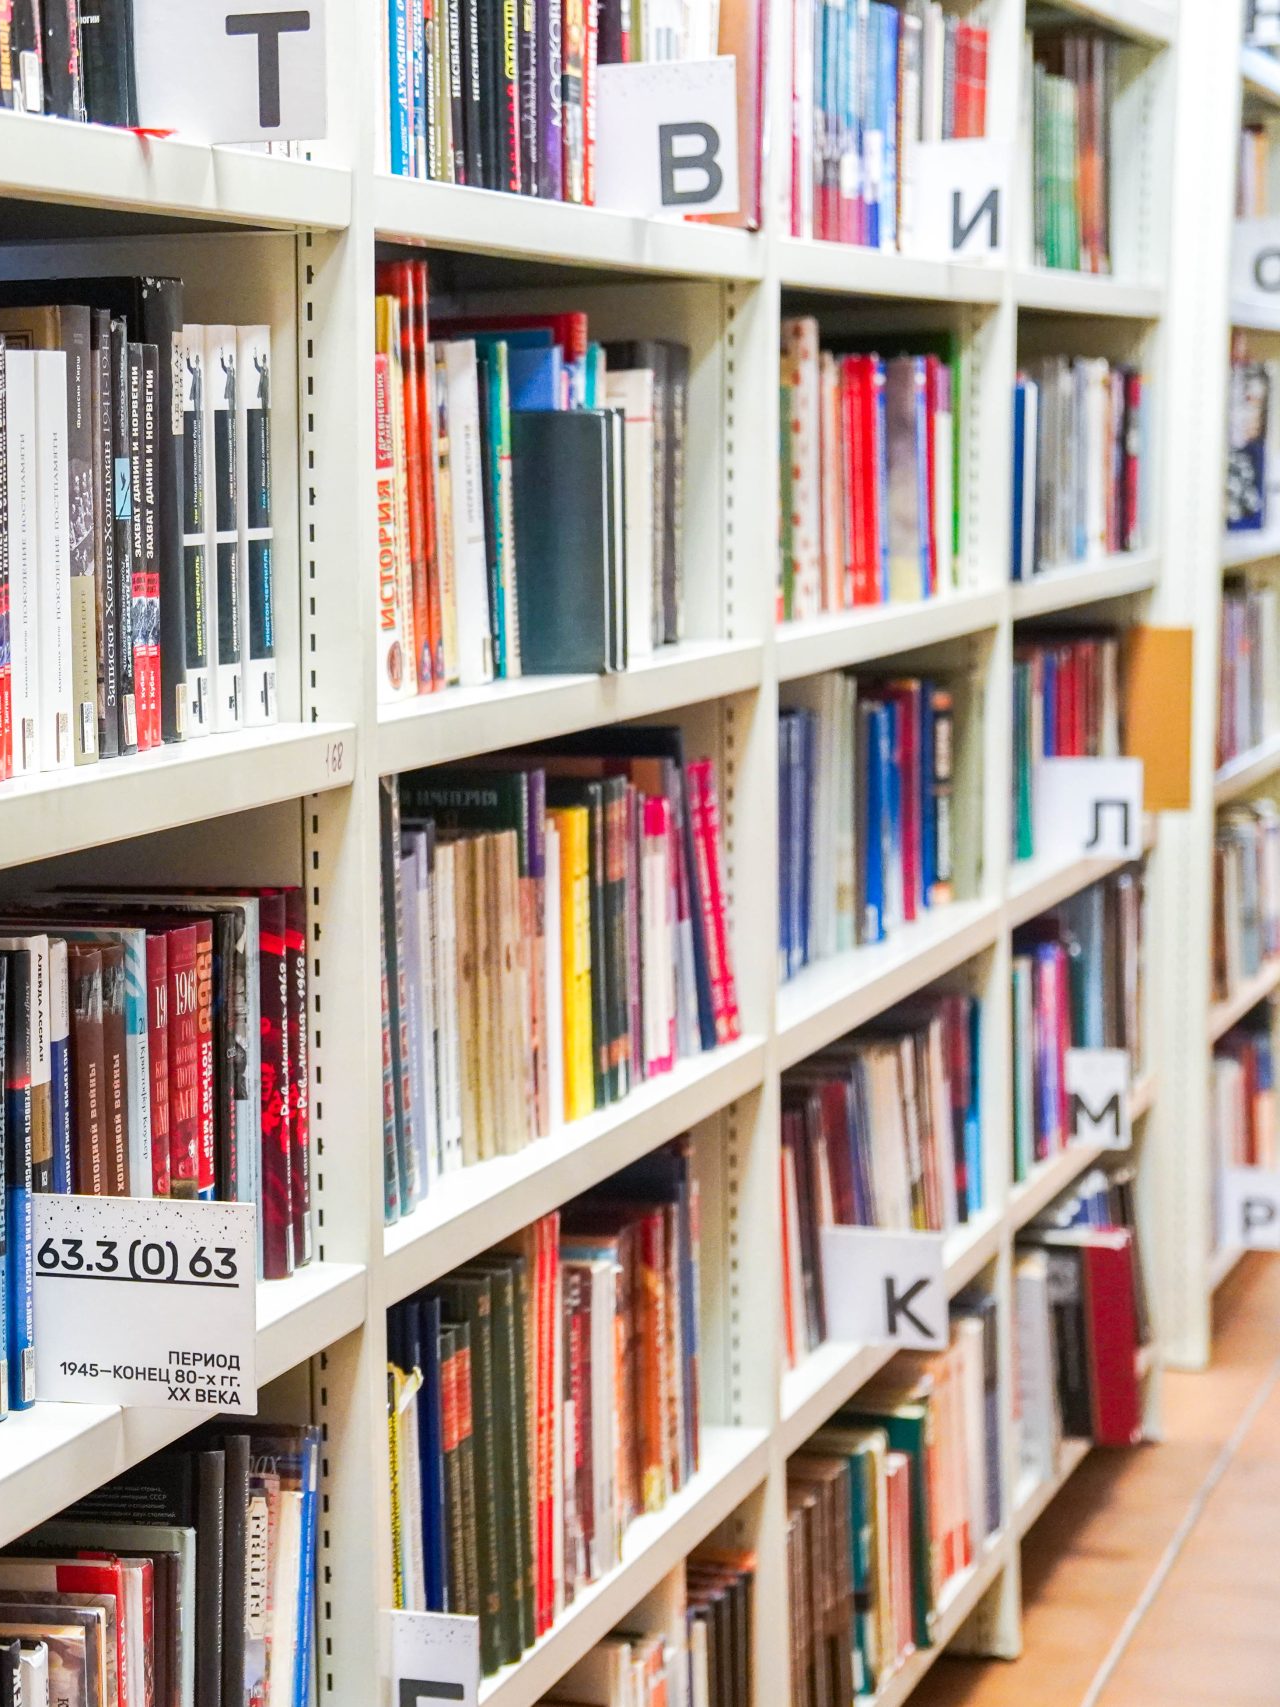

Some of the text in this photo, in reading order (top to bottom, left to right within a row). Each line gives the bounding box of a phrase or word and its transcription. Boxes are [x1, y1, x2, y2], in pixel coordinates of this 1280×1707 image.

[225, 10, 311, 128] Т
[658, 120, 724, 206] В
[949, 187, 1000, 251] И
[74, 355, 83, 429] Франсин Хирш
[130, 365, 144, 558] ЗАХВАТ ДАНИИ И НОРВЕГИИ
[144, 369, 154, 559] ЗАХВАТ ДАНИИ И НОРВЕГИИ
[101, 332, 116, 707] Записки Хелене Хольцман 1941-1944
[376, 478, 396, 632] ИСТОРИЯ
[195, 610, 203, 657] УИНСТОН
[263, 602, 271, 647] УИНСТОН
[1086, 798, 1131, 849] Л
[24, 1083, 32, 1134] КРЕПОСТЬ
[88, 1062, 98, 1120] ВОЙНЫ
[201, 1042, 211, 1158] ПОТРЯС МИР
[1072, 1092, 1120, 1139] М
[113, 1053, 126, 1192] ХОЛОДНОЙ ВОЙНЫ
[24, 1136, 32, 1200] ОСКАРСБОРГ
[25, 1202, 33, 1241] ПРОТИВ
[25, 1243, 33, 1293] КРЕЙСЕРА
[36, 1238, 238, 1281] 63.3 (0) 63
[882, 1275, 936, 1340] К
[168, 1350, 241, 1371] ПЕРИОД
[174, 1369, 217, 1386] 80-х
[220, 1375, 241, 1388] гг.
[195, 1388, 241, 1406] ВЕКА
